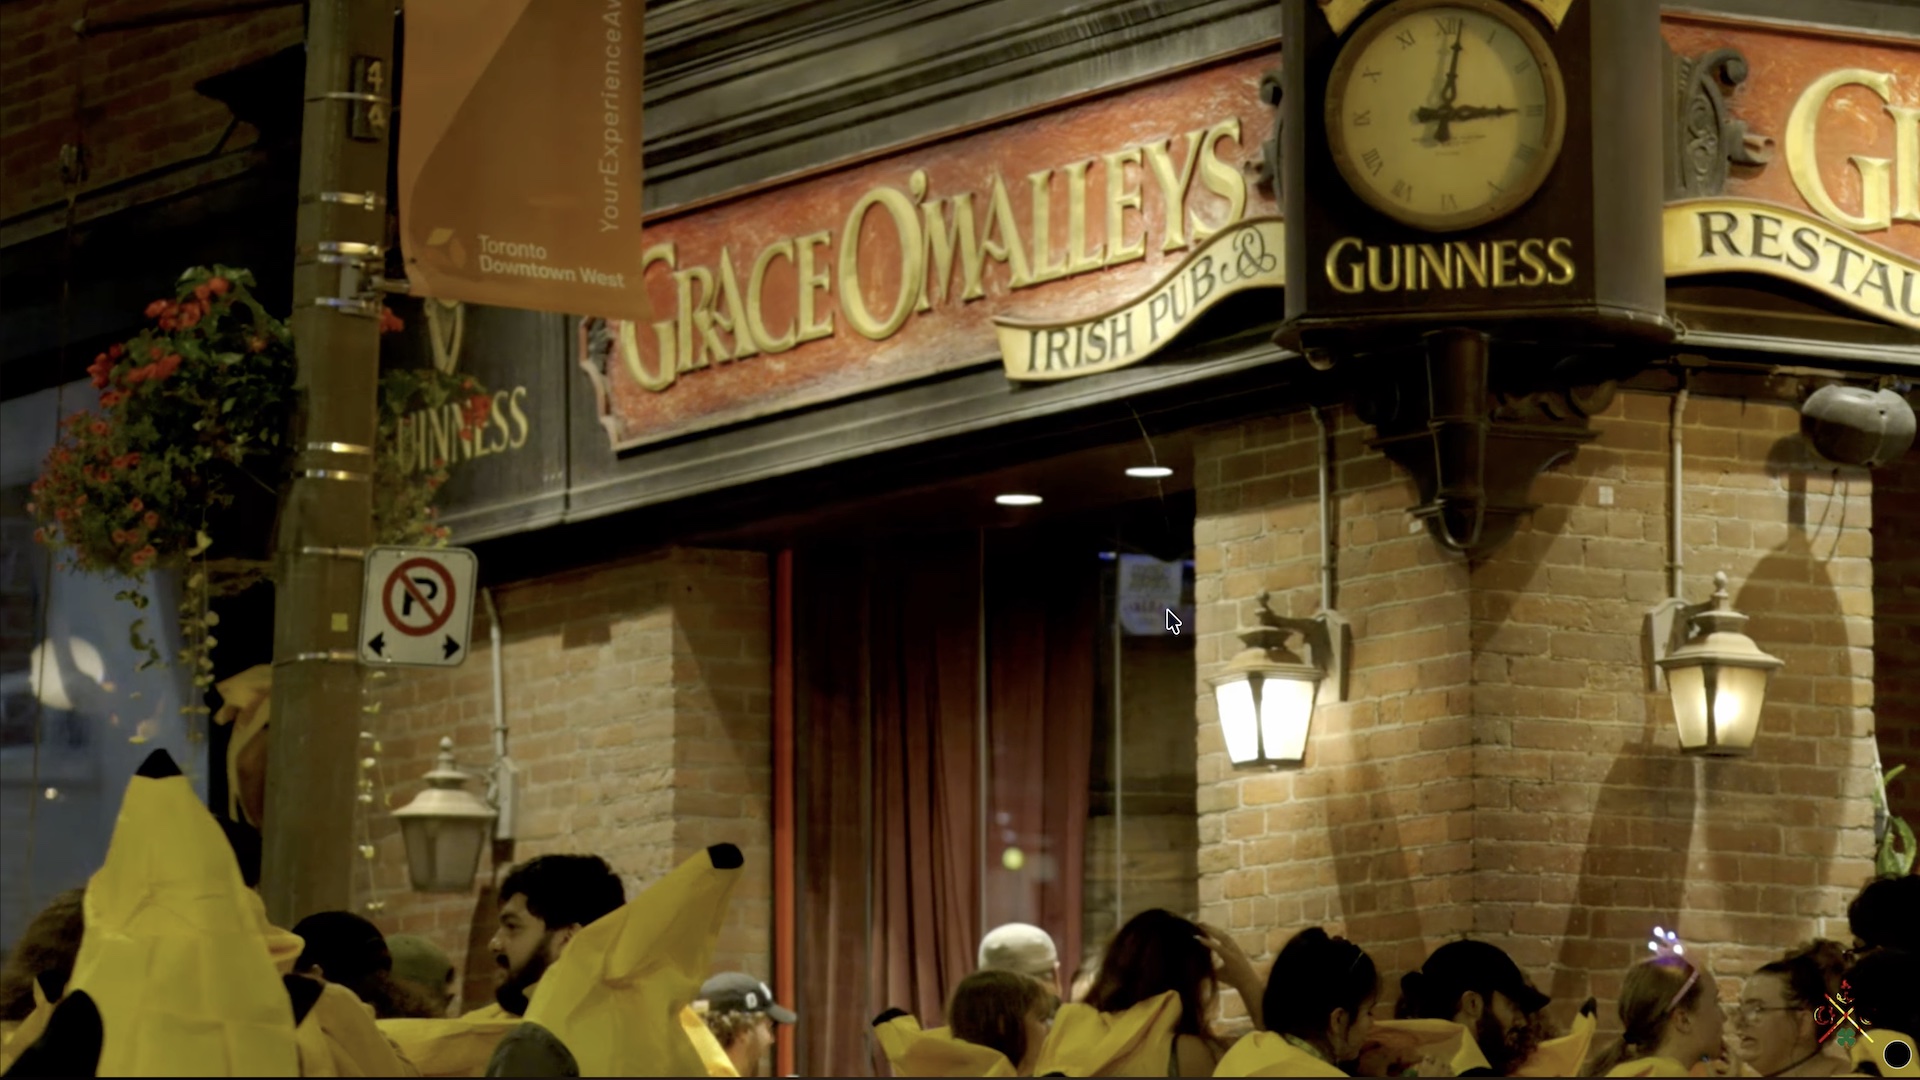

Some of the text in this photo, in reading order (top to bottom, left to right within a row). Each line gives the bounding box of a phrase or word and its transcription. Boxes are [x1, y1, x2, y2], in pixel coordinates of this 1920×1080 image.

[477, 234, 547, 261] Toronto
[479, 254, 625, 288] Downtown West
[620, 115, 1247, 391] GRACE O'MALLEYS
[1325, 236, 1576, 294] GUINNESS
[1027, 312, 1134, 372] IRISH
[1147, 254, 1217, 341] PUB
[398, 386, 528, 474] UINNESS
